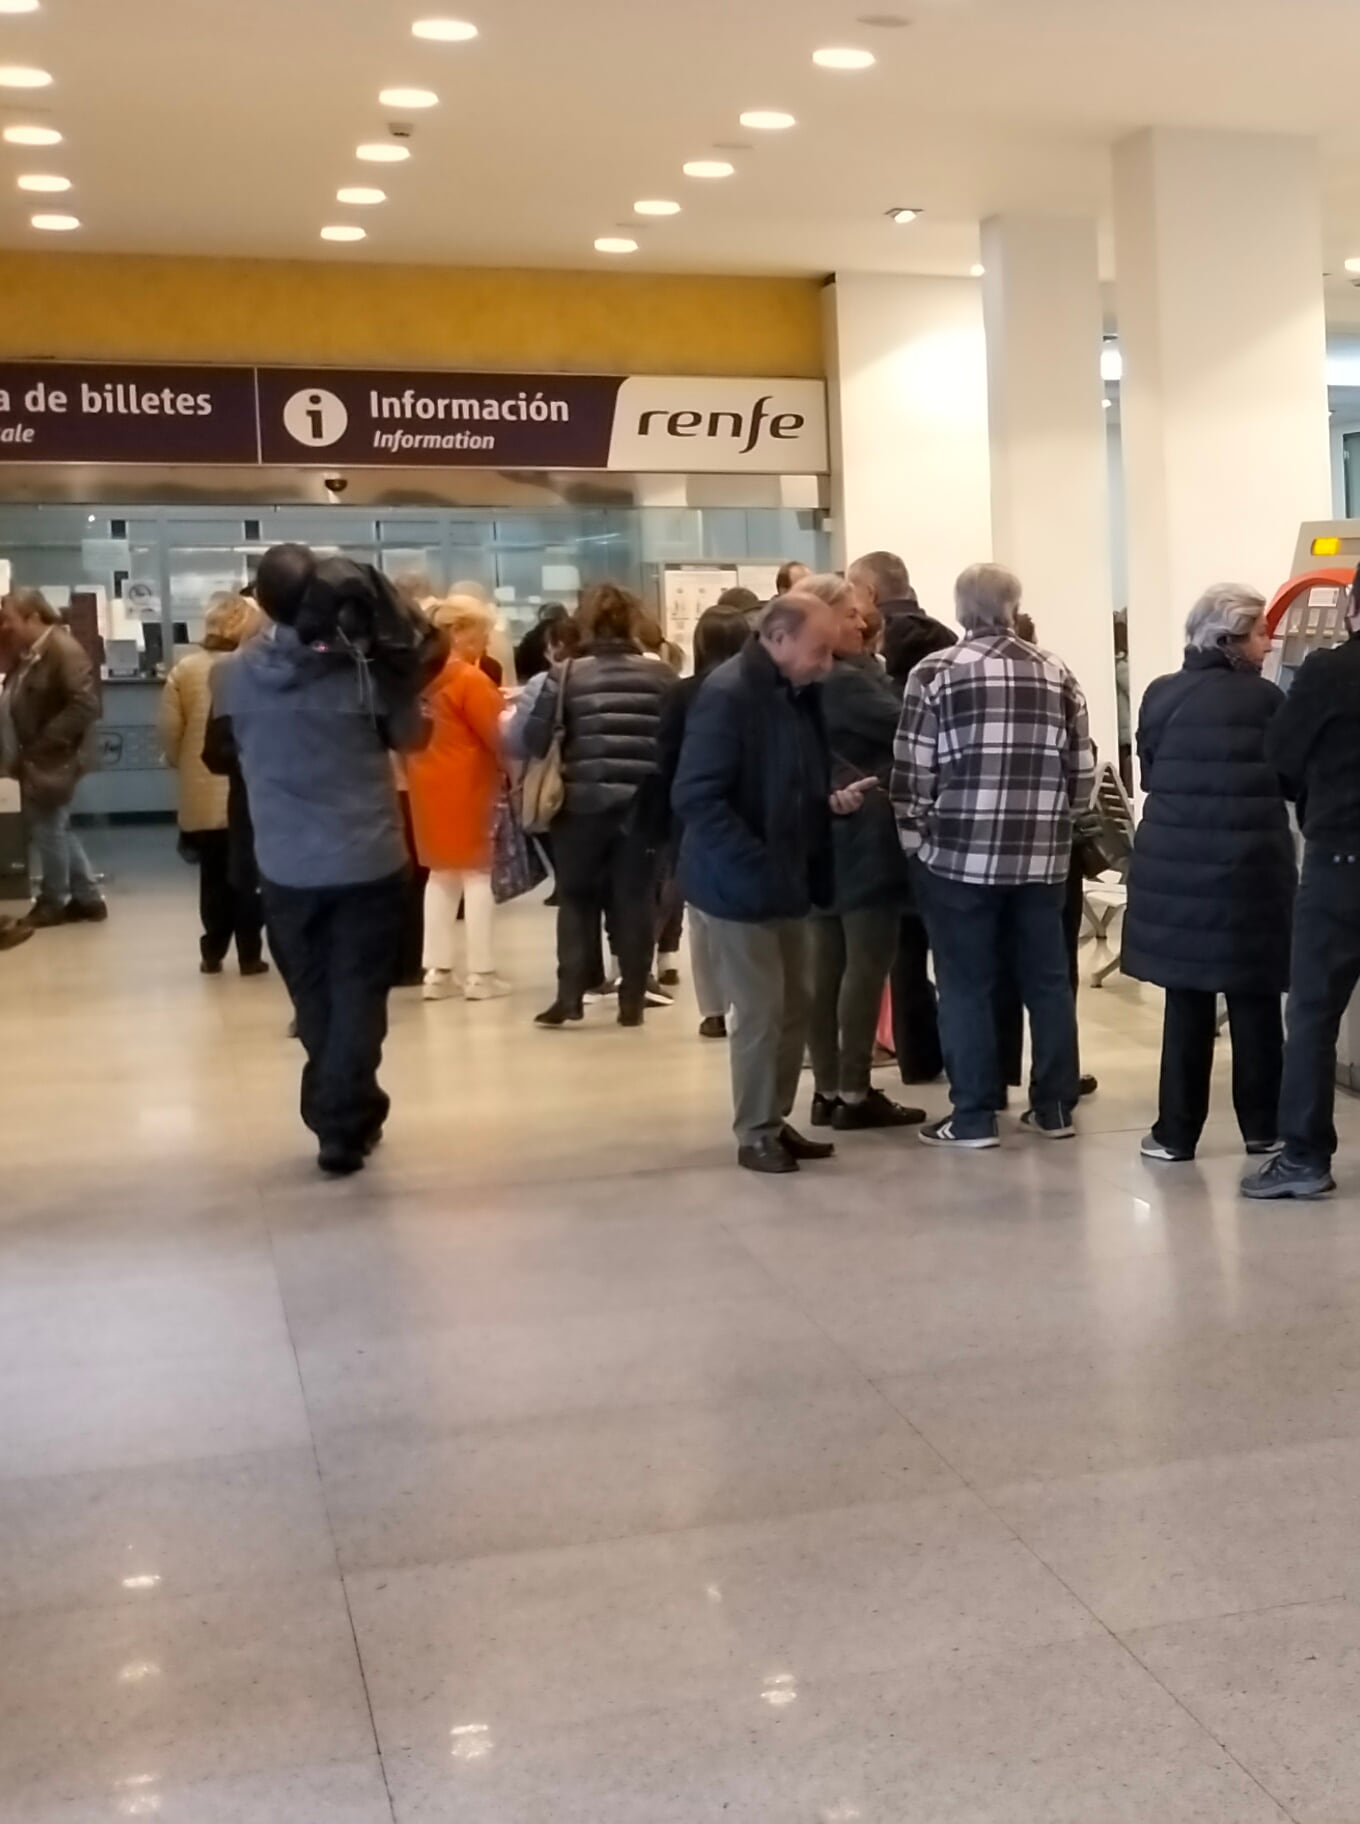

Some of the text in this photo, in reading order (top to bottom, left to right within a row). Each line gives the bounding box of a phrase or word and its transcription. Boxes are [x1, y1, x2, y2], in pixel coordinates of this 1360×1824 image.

[24, 382, 67, 412] de
[81, 383, 212, 415] billetes
[369, 389, 570, 422] Información
[0, 423, 35, 443] ale
[373, 430, 495, 452] Information
[637, 395, 805, 454] renfe
